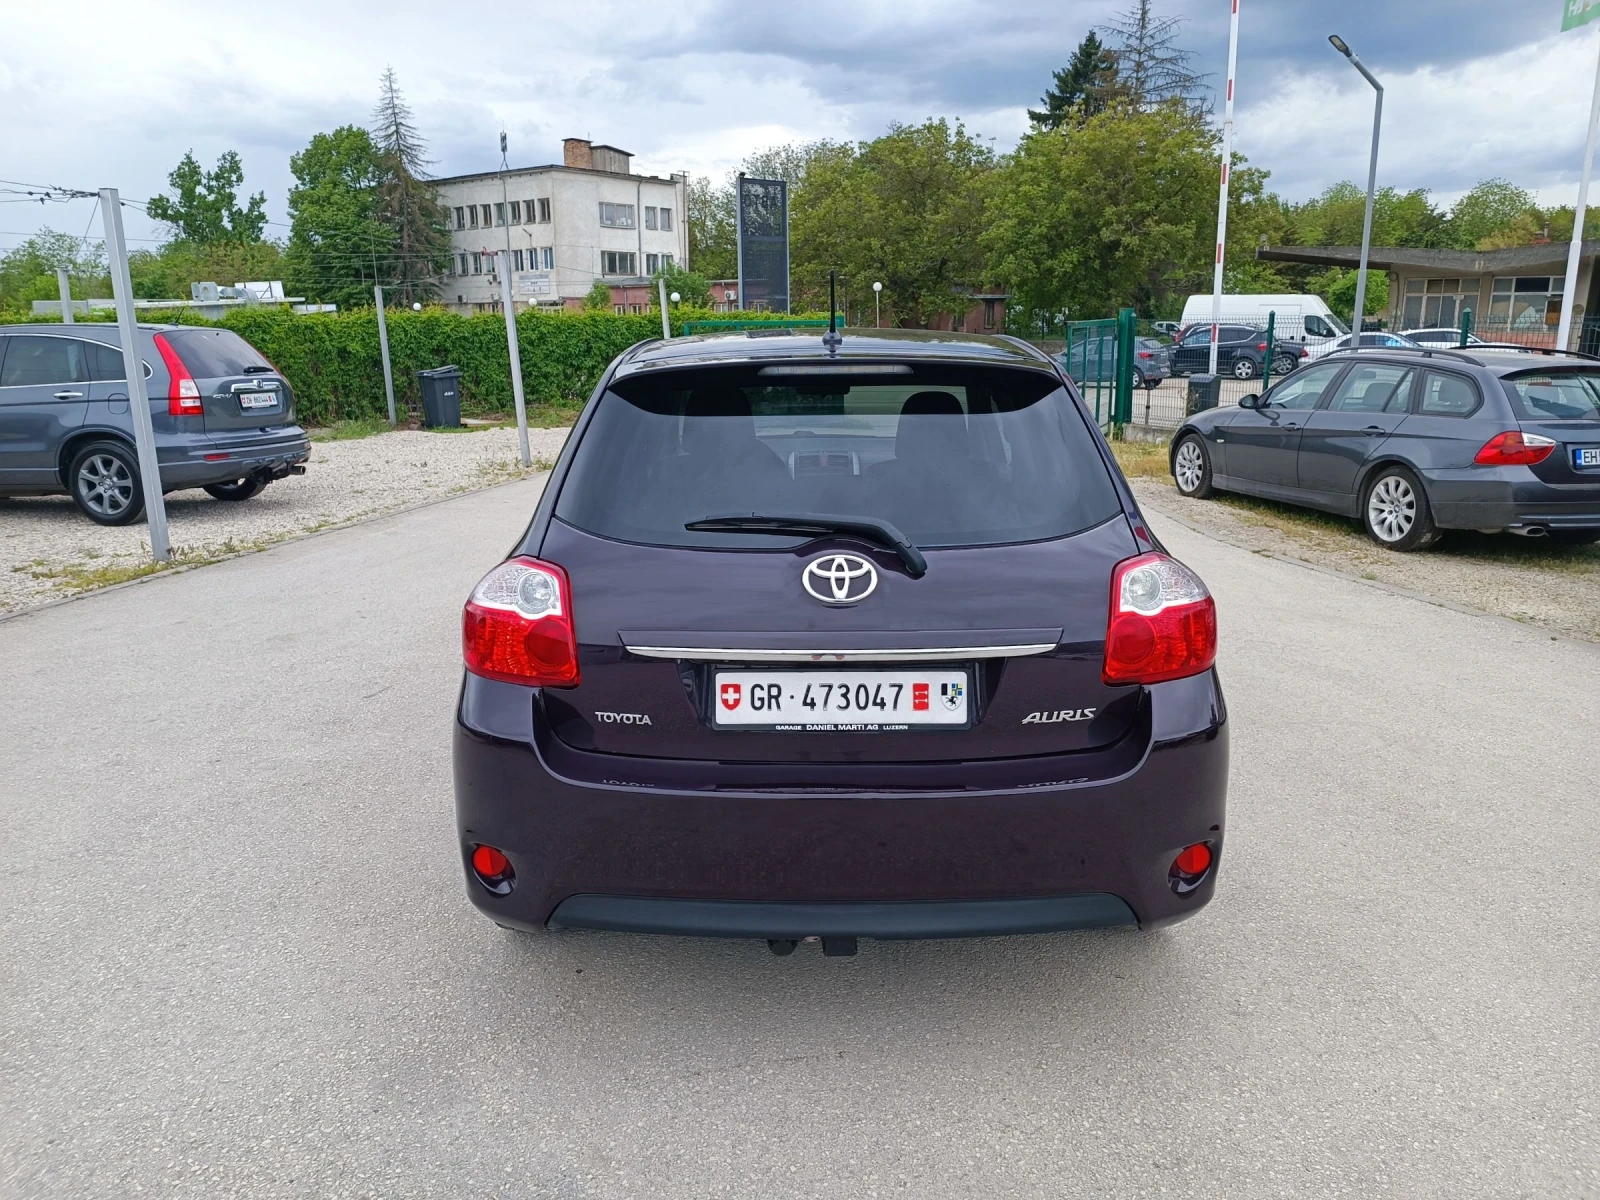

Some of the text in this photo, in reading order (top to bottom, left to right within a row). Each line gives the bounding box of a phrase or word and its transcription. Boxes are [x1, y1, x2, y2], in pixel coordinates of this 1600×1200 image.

[801, 683, 904, 712] 473047
[594, 711, 653, 726] TOYOTA
[1021, 707, 1097, 725] AURIS
